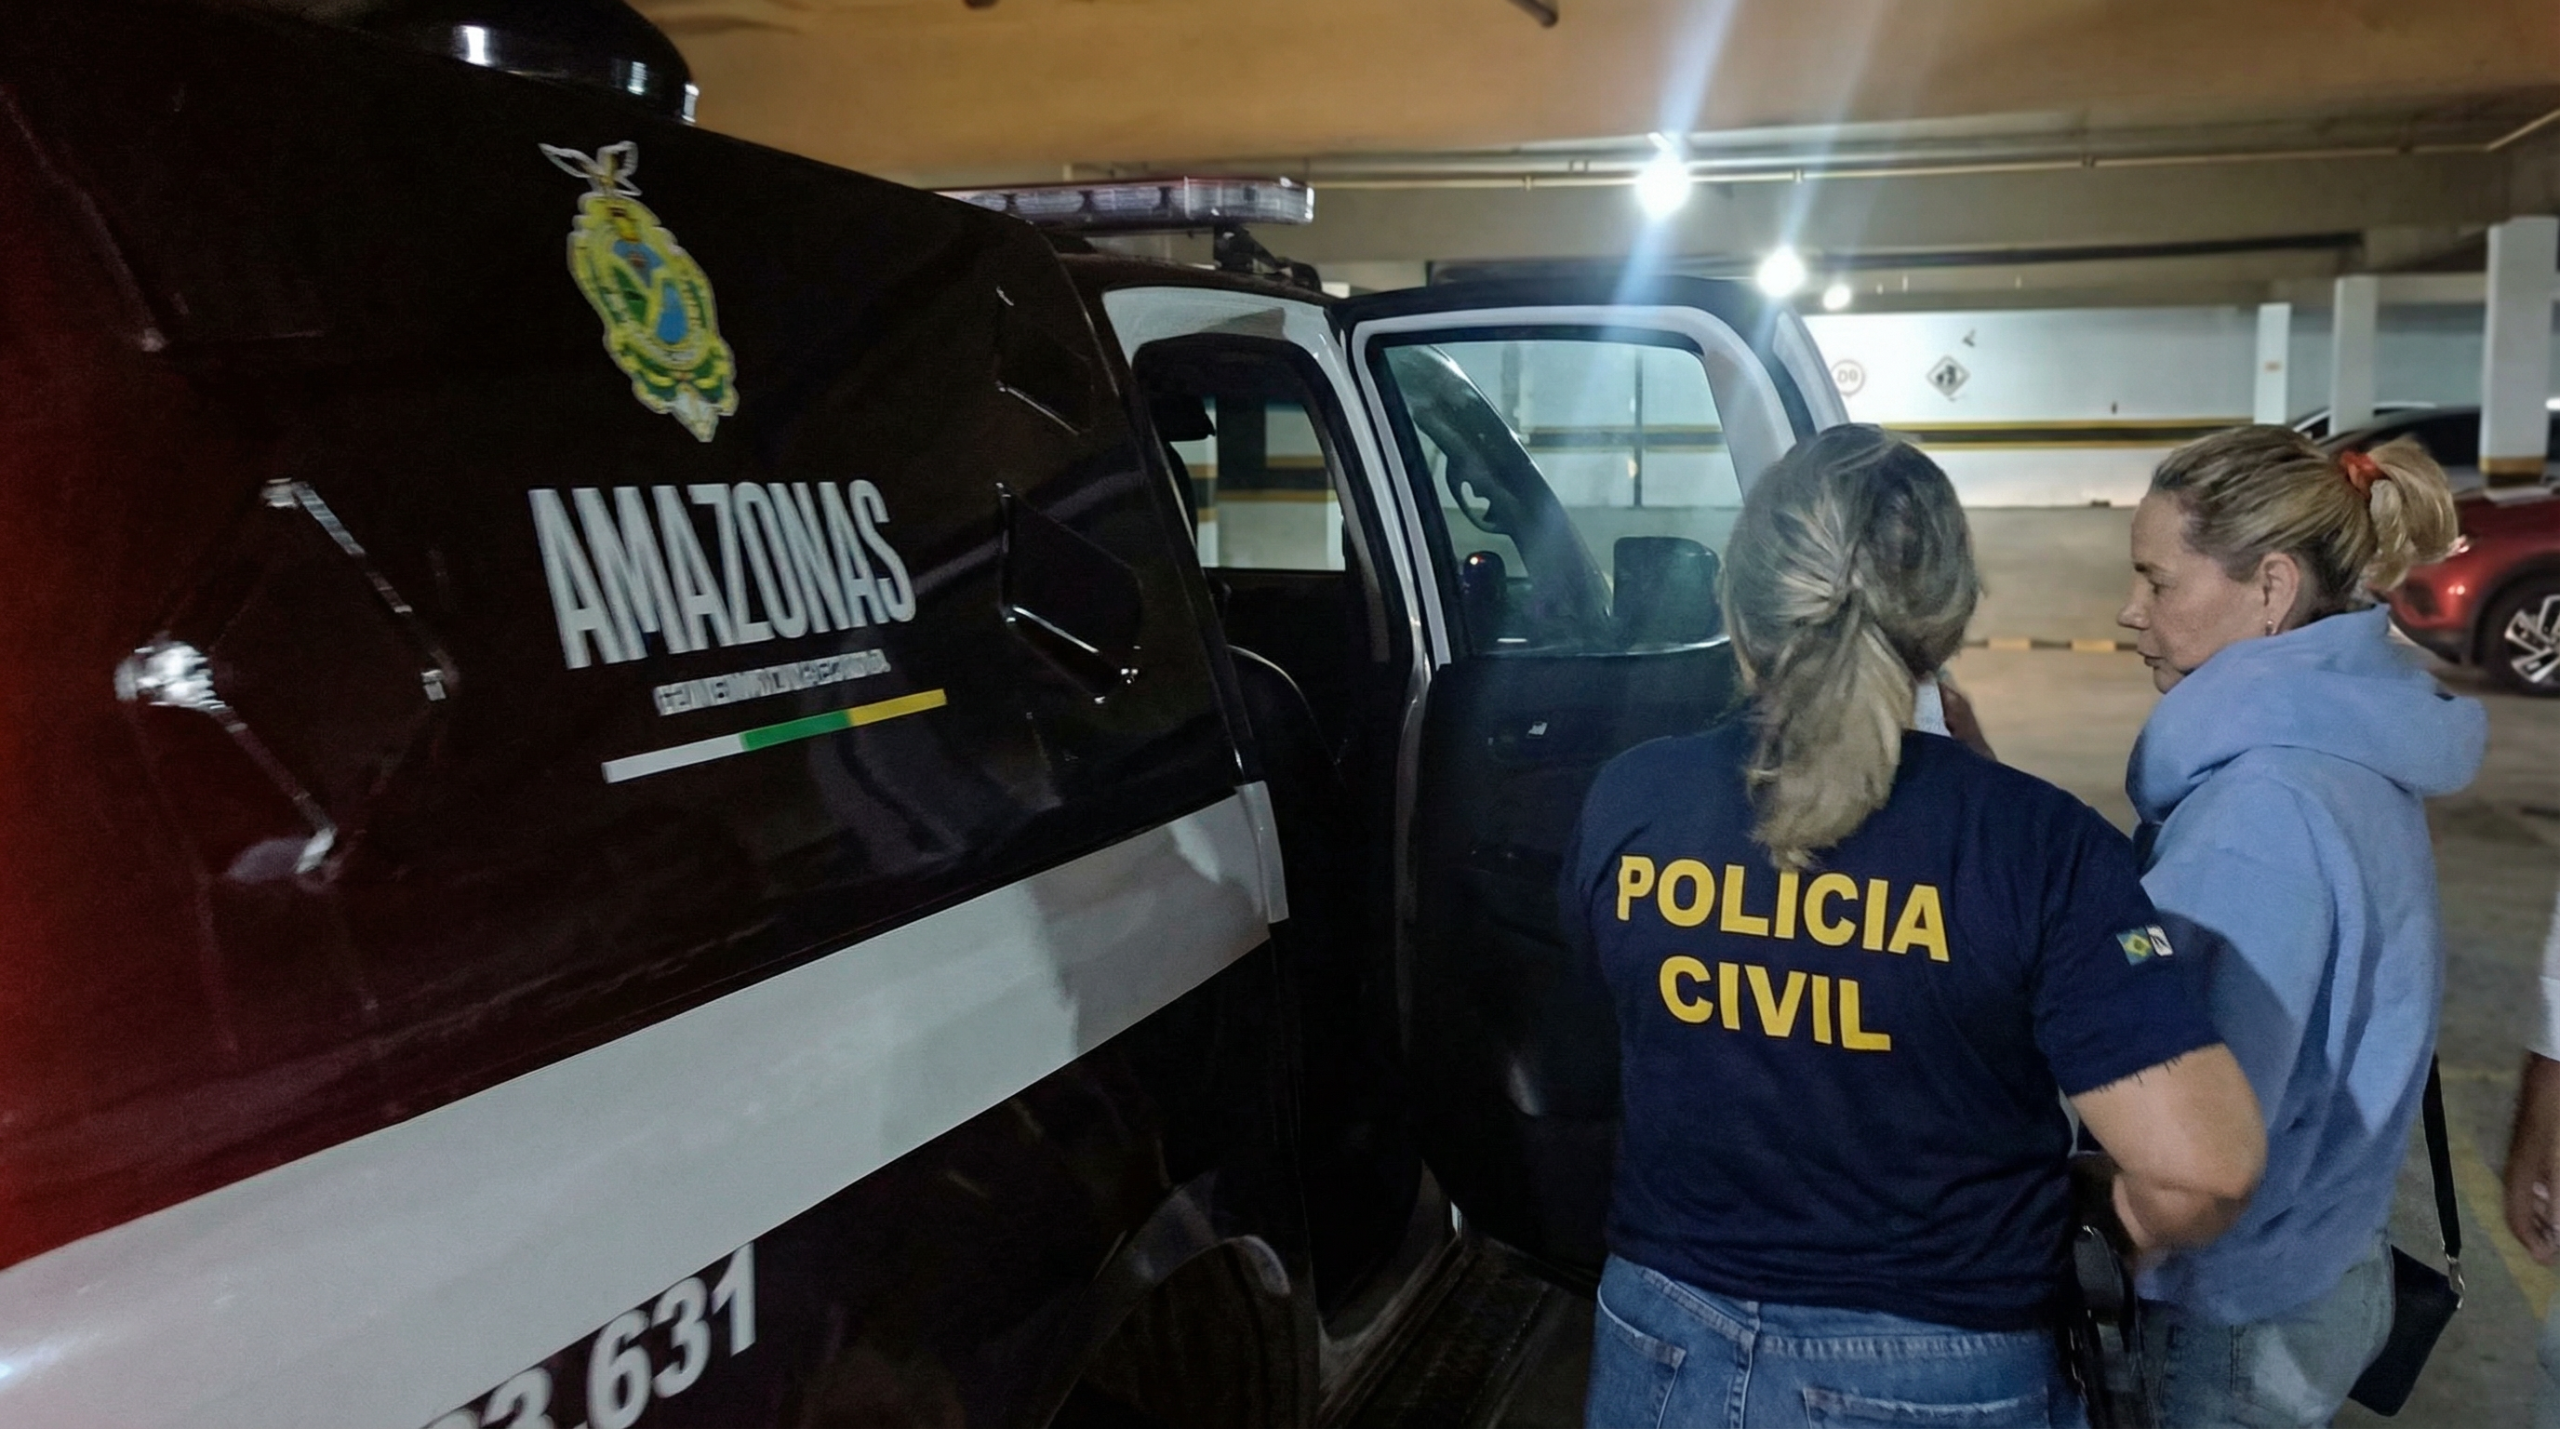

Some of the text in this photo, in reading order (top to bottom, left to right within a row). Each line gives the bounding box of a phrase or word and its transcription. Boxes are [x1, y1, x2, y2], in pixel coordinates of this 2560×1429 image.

[529, 479, 916, 669] AMAZONAS
[1617, 855, 1950, 962] POLICIA
[1660, 955, 1892, 1051] CIVIL
